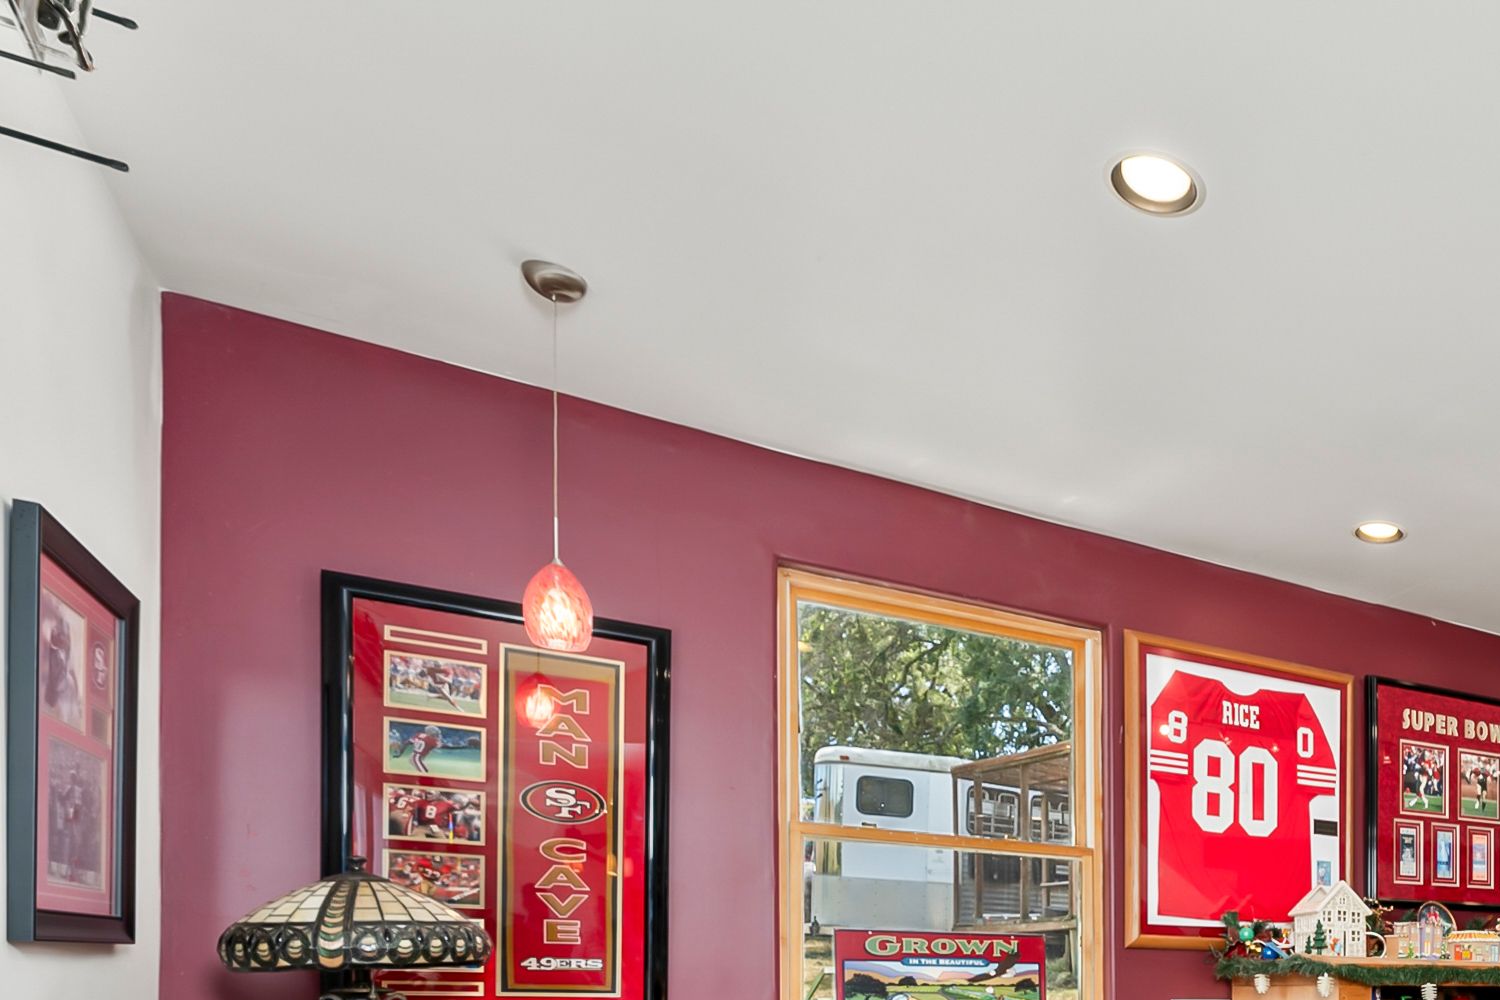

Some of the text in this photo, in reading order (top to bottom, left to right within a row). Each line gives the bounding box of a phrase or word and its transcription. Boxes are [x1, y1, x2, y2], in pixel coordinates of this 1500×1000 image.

[535, 683, 592, 769] MAN
[1168, 710, 1188, 744] 8
[1222, 700, 1260, 730] RICE
[1402, 708, 1459, 737] SUPER
[1296, 727, 1314, 758] 0
[545, 787, 591, 818] SF
[1191, 738, 1278, 838] 80
[425, 805, 437, 819] 8
[535, 837, 591, 945] CAVE
[865, 935, 1019, 957] GROWN
[520, 956, 603, 971] 49ERS
[939, 958, 985, 966] BEAUTIFUL
